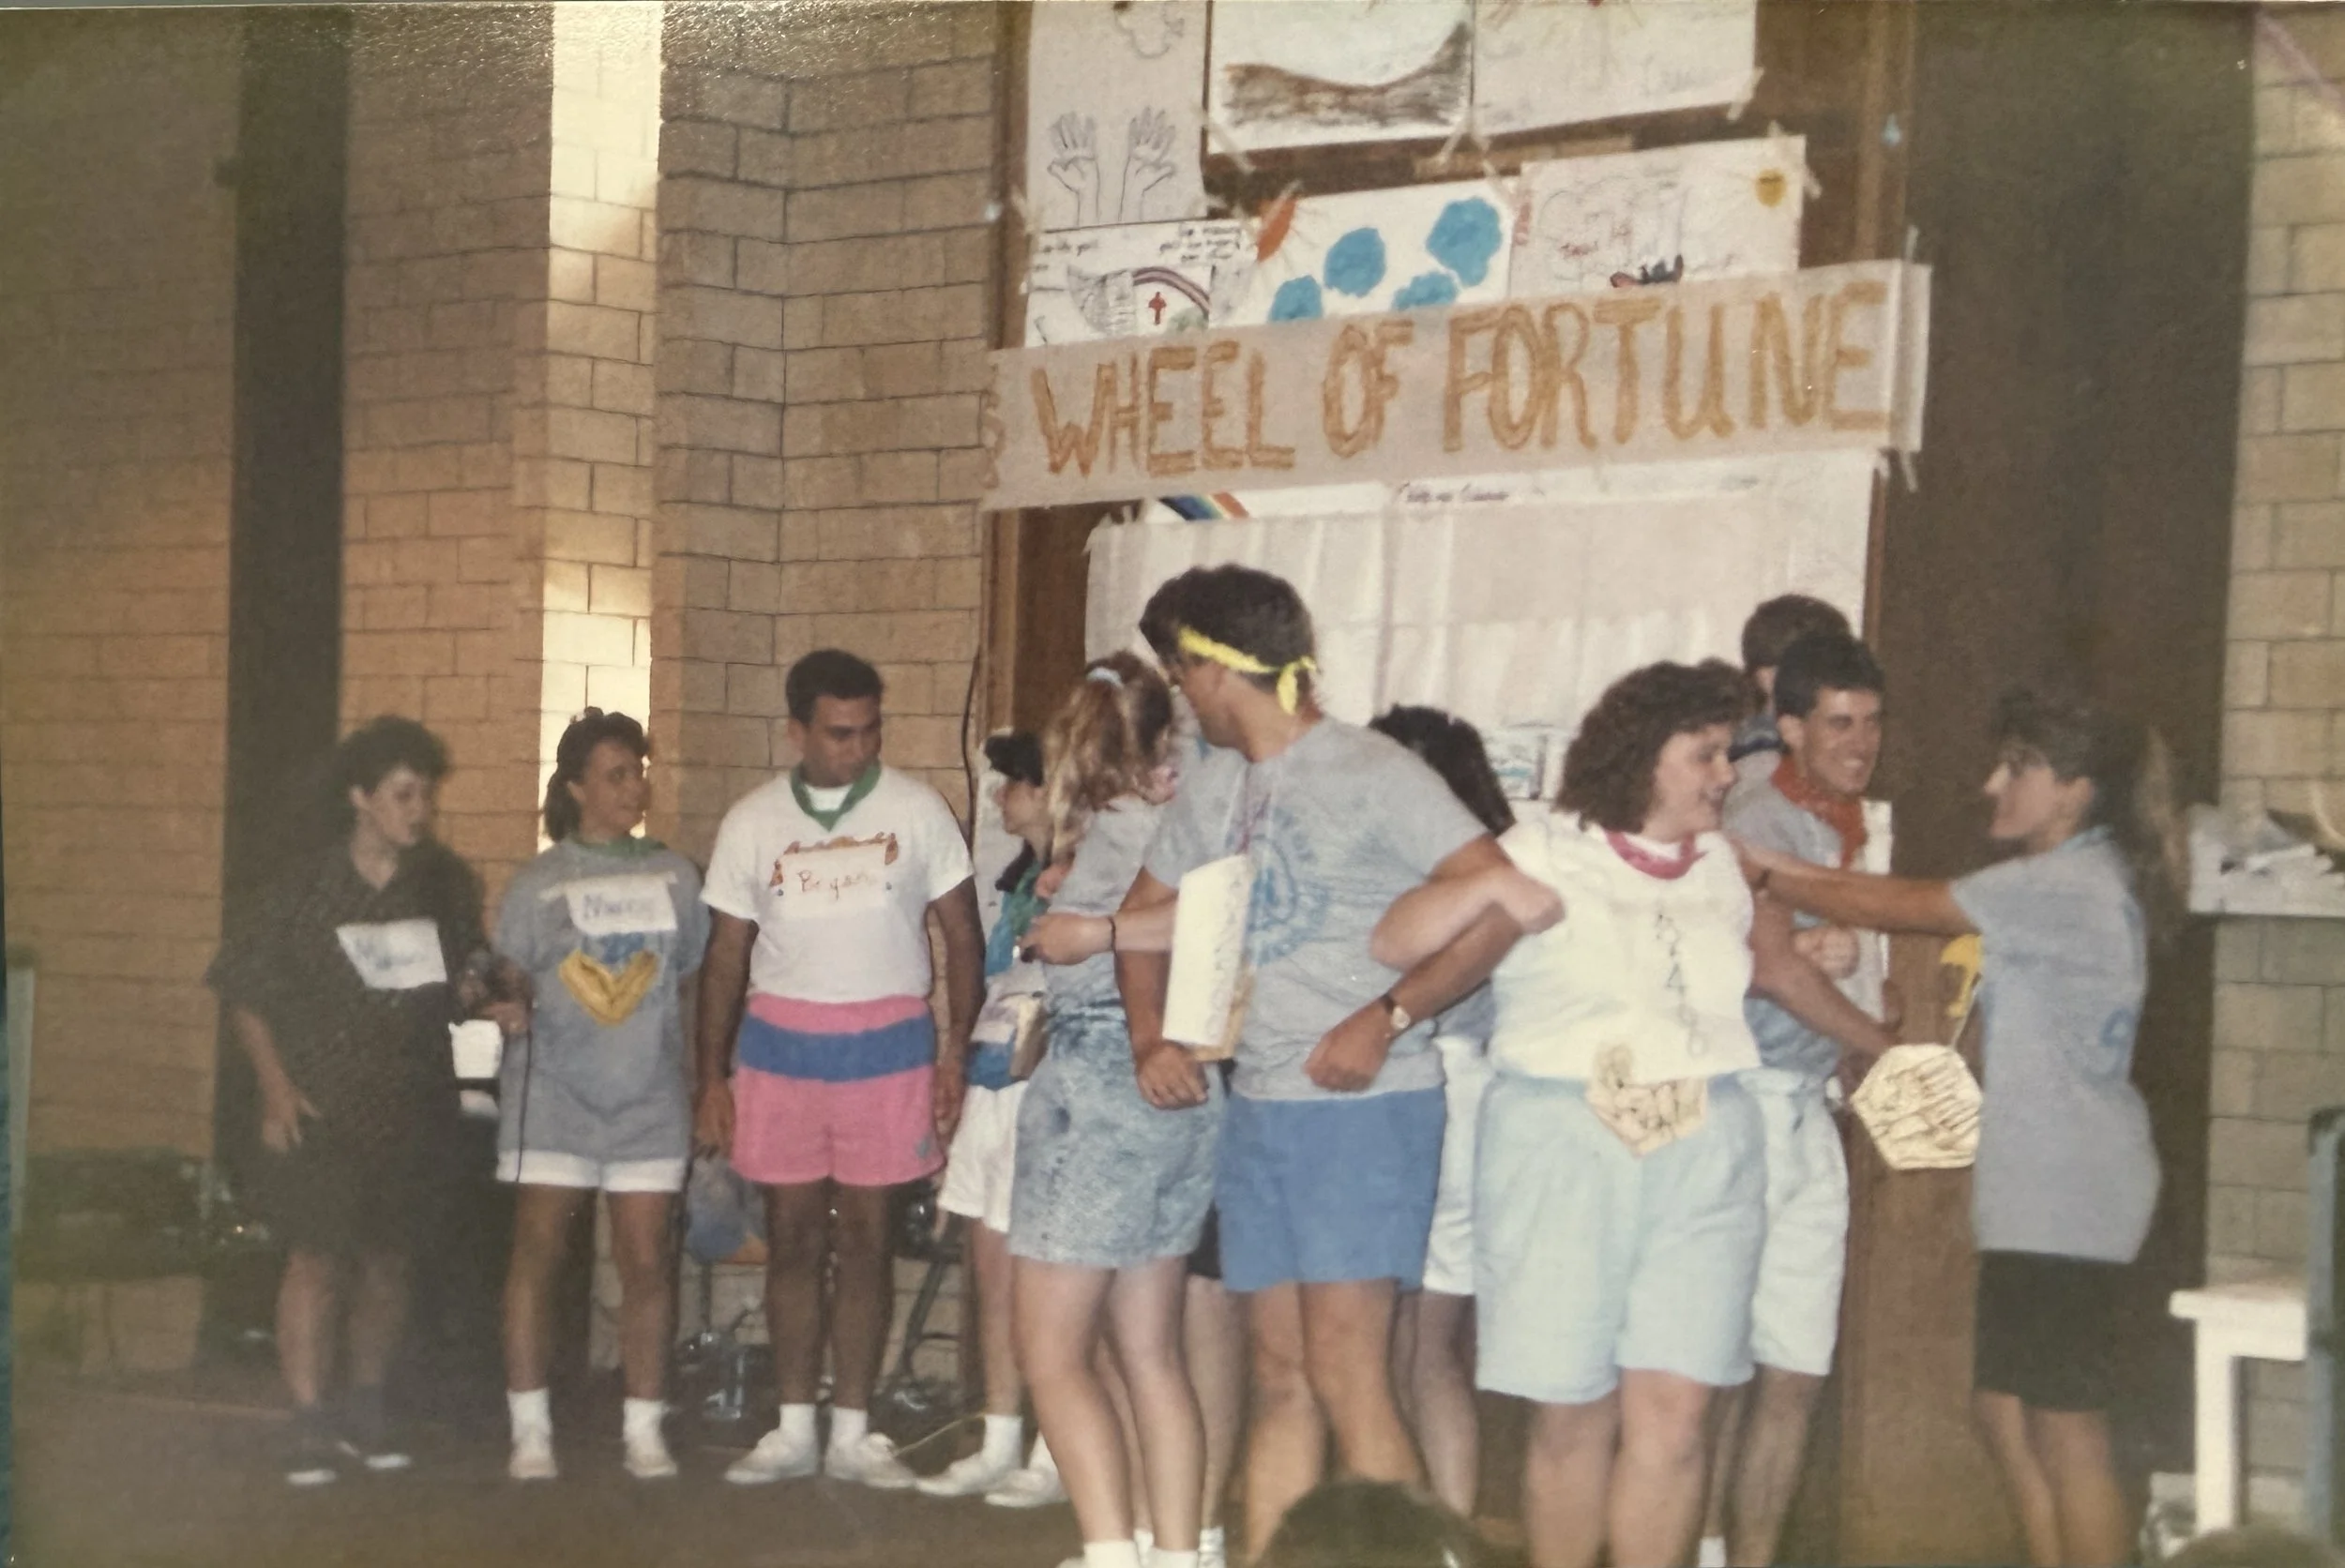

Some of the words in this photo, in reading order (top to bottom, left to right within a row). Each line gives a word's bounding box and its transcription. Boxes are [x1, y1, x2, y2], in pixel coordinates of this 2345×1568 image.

[1034, 340, 1295, 477] WHEEL
[1323, 318, 1415, 459] OF
[1442, 279, 1891, 452] FORTUNE
